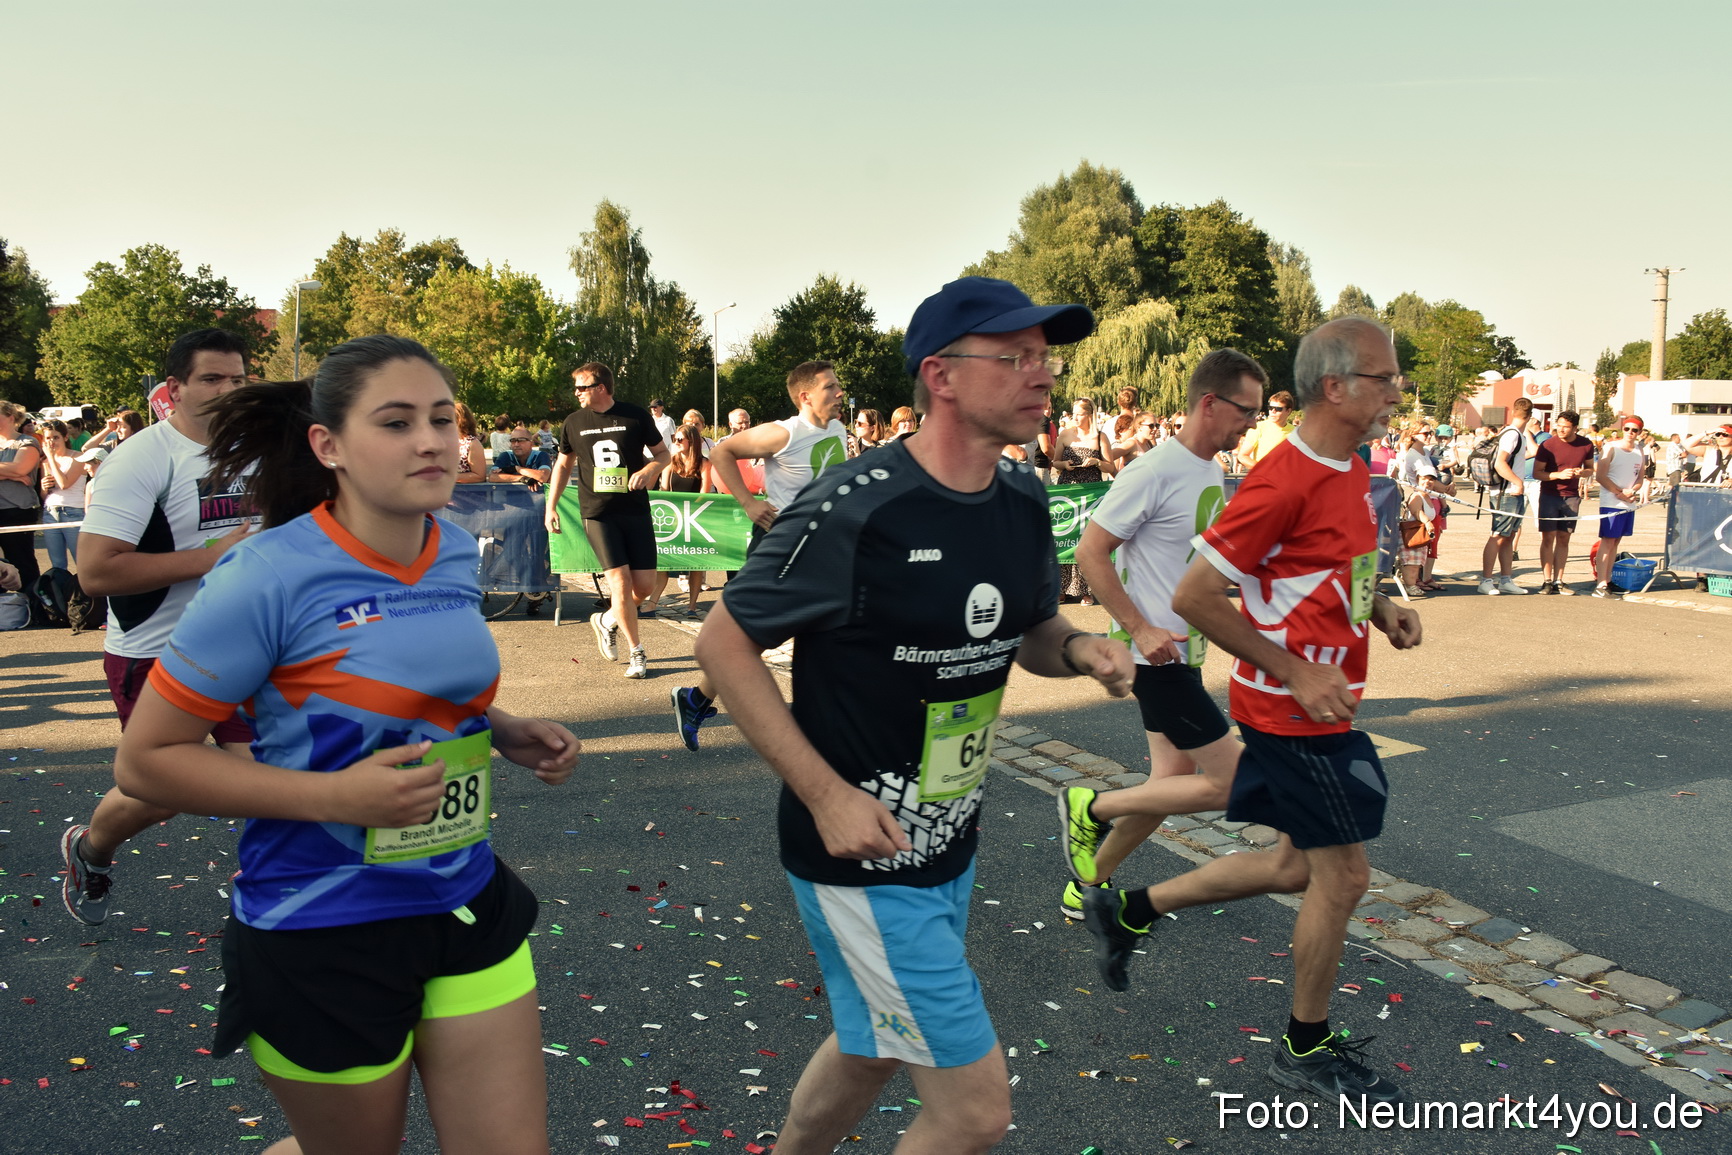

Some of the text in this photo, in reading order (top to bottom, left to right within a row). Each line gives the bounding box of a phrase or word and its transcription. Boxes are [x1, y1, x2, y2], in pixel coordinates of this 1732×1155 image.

[592, 439, 621, 468] 6
[599, 475, 623, 486] 1931
[908, 548, 943, 562] JAKO
[421, 774, 479, 825] 88
